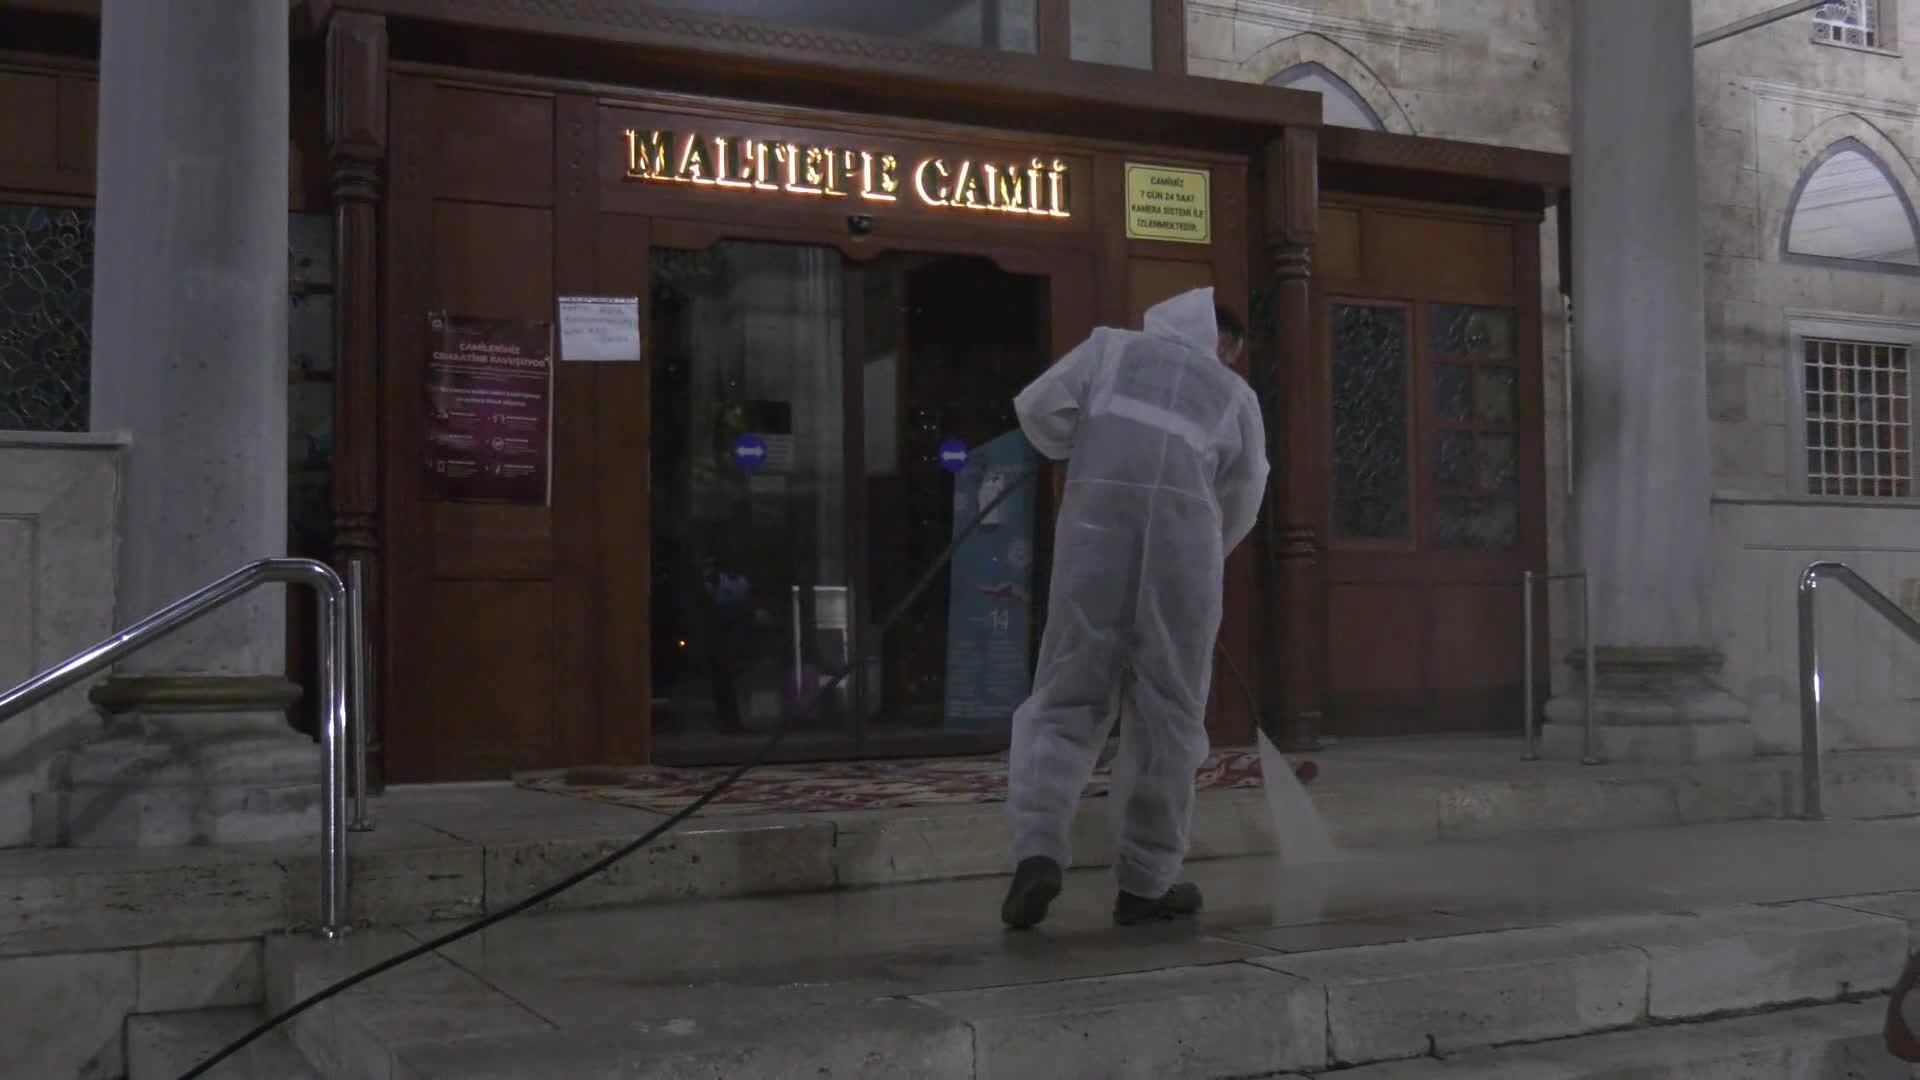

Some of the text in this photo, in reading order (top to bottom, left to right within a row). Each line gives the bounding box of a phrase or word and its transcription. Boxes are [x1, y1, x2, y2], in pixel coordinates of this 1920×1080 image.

[624, 128, 1071, 217] MALTEPE CAMİİ
[1165, 192, 1175, 201] 24
[1176, 193, 1195, 203] SAAT
[1131, 203, 1161, 215] KAMERA
